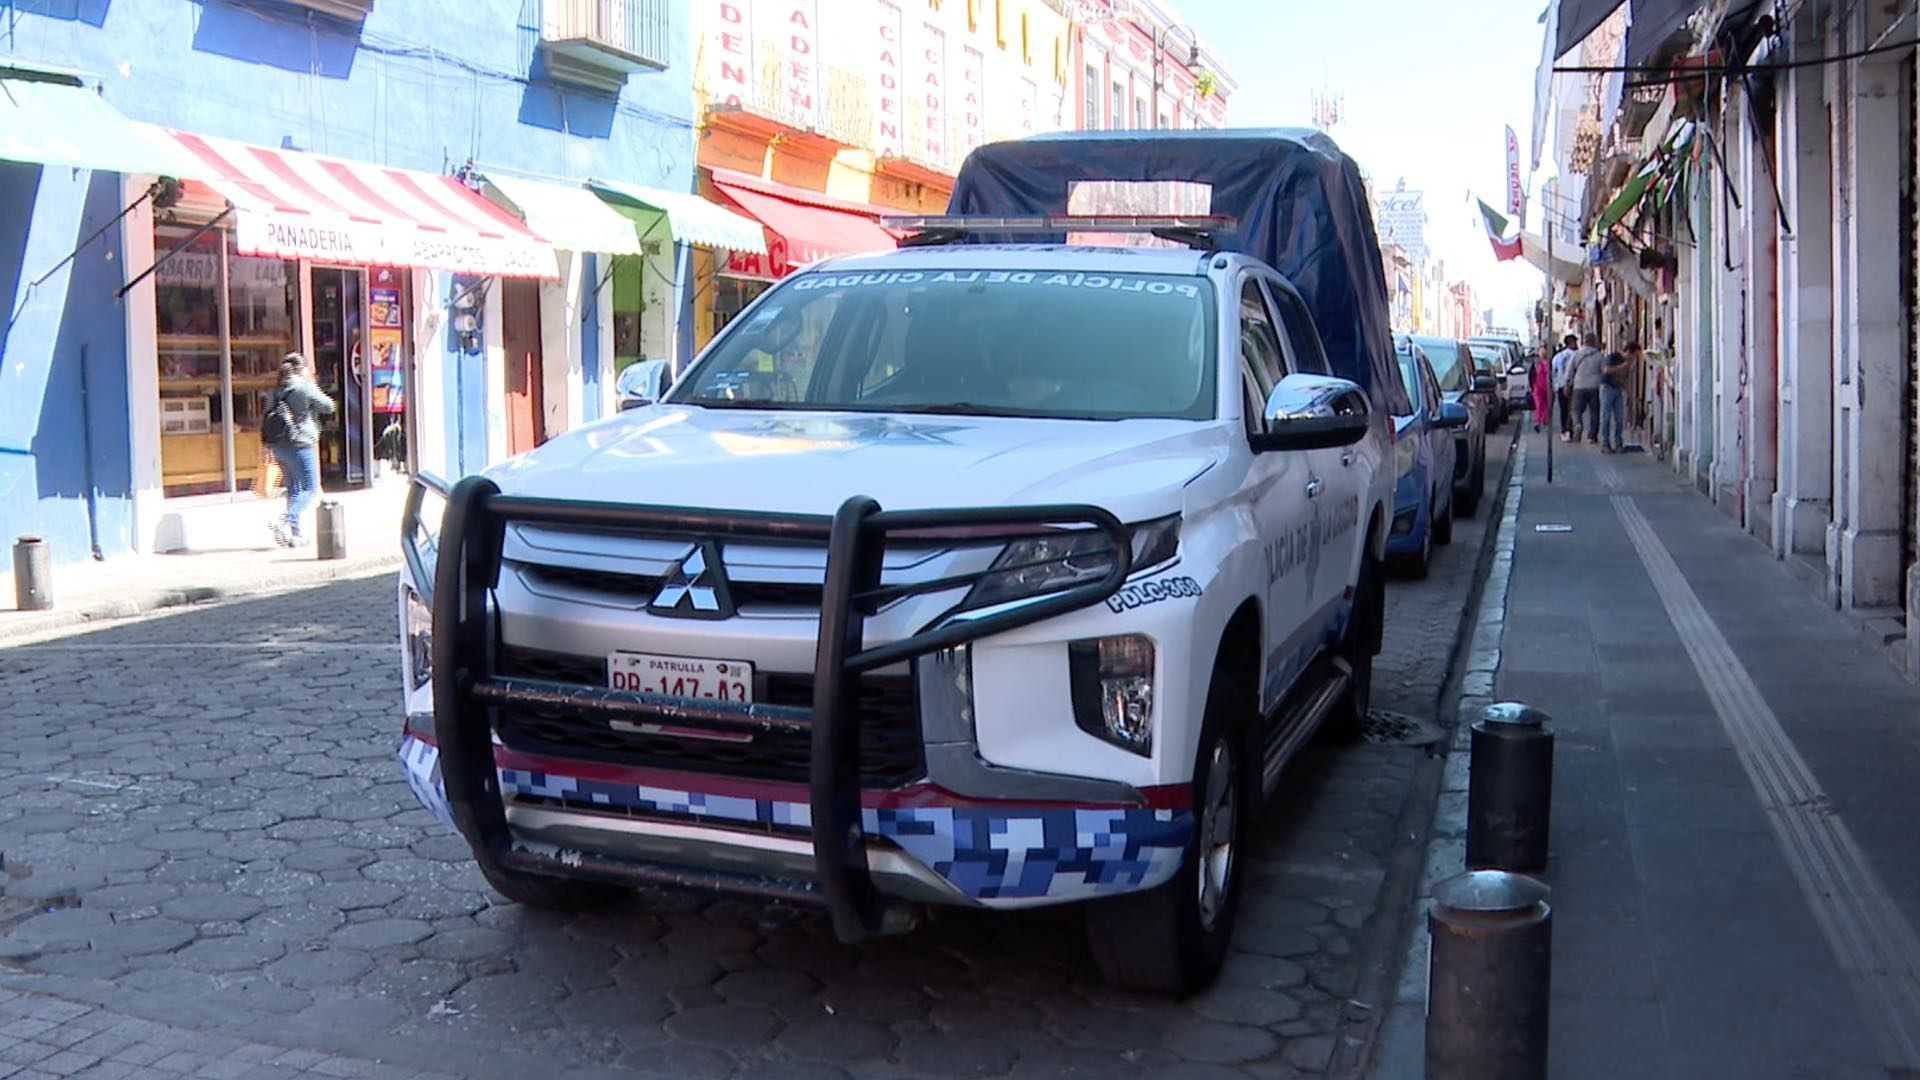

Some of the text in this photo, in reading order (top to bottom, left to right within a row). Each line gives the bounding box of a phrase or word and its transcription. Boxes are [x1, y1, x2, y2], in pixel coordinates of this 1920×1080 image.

[267, 223, 353, 252] PANADERIA
[1105, 576, 1203, 613] PDLC-368
[649, 660, 705, 674] PATRULLA
